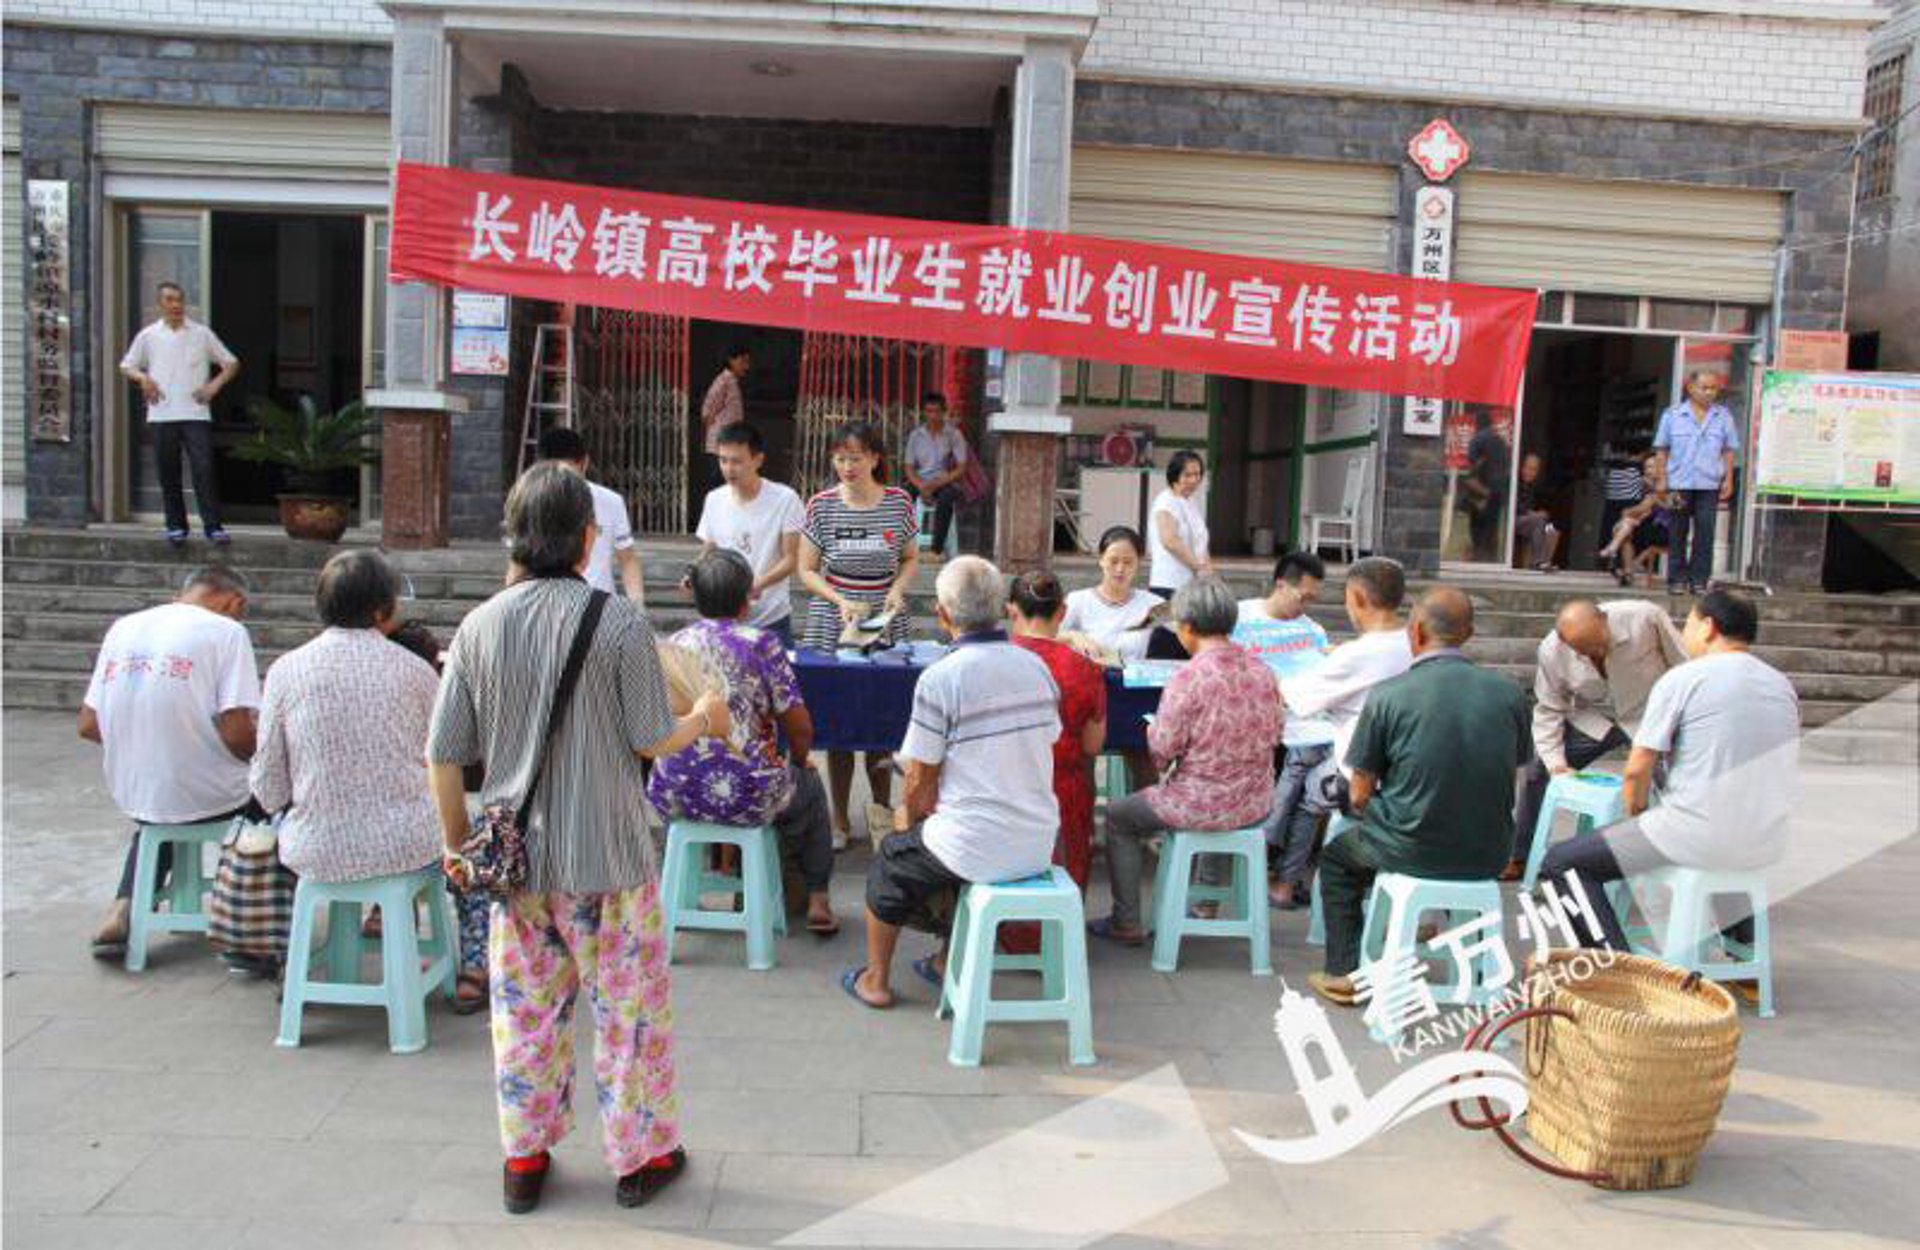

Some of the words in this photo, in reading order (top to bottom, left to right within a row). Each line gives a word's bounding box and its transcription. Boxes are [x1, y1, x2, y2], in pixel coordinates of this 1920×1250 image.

[467, 191, 1461, 366] 长岭镇高校毕业生就业创业宣传活动
[1421, 227, 1442, 279] 万州区
